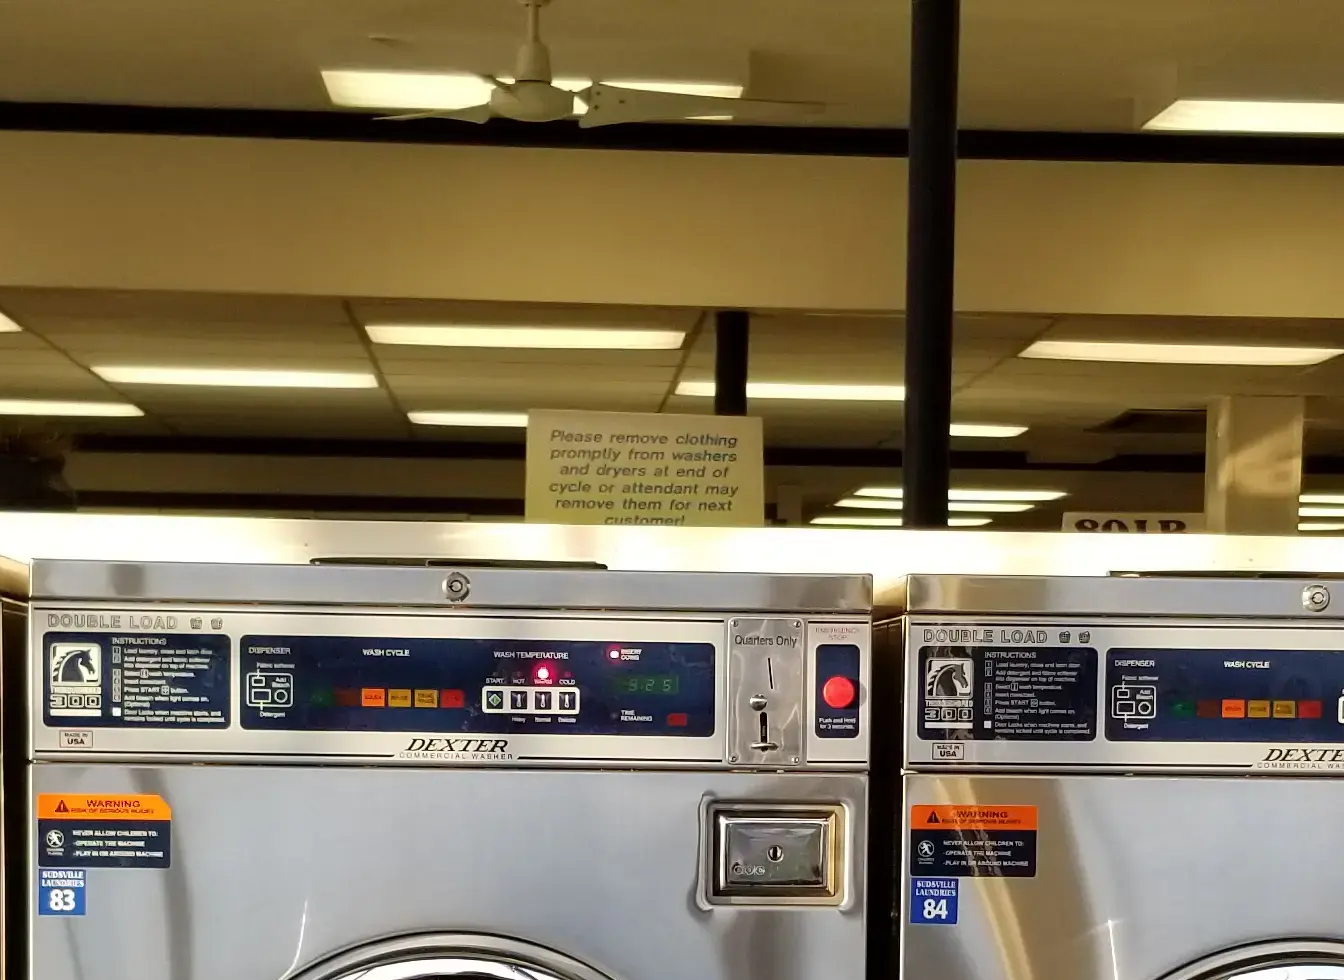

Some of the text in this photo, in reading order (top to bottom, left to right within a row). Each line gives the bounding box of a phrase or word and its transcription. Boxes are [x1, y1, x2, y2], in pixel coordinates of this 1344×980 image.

[550, 430, 737, 448] Please remove clothing
[550, 448, 737, 462] promptly from washers
[560, 463, 729, 478] and dryers at end of
[549, 481, 738, 497] cycle or attendant may
[556, 499, 732, 511] remove them for next
[48, 614, 178, 629] DOUBLE LOAD
[735, 635, 797, 648] Quarters Only
[924, 629, 1048, 644] DOUBLE LOAD
[386, 649, 410, 657] CYCLE
[494, 651, 568, 660] WASH TEMPERATURE
[1246, 661, 1270, 669] CYCLE
[406, 739, 508, 752] DEXTER
[87, 800, 140, 808] WARNING
[42, 879, 84, 887] LAUNDRIES
[917, 880, 956, 888] SUDSVILLE
[916, 888, 956, 896] LAUNDRIES
[50, 889, 75, 910] 83
[923, 898, 948, 919] 84
